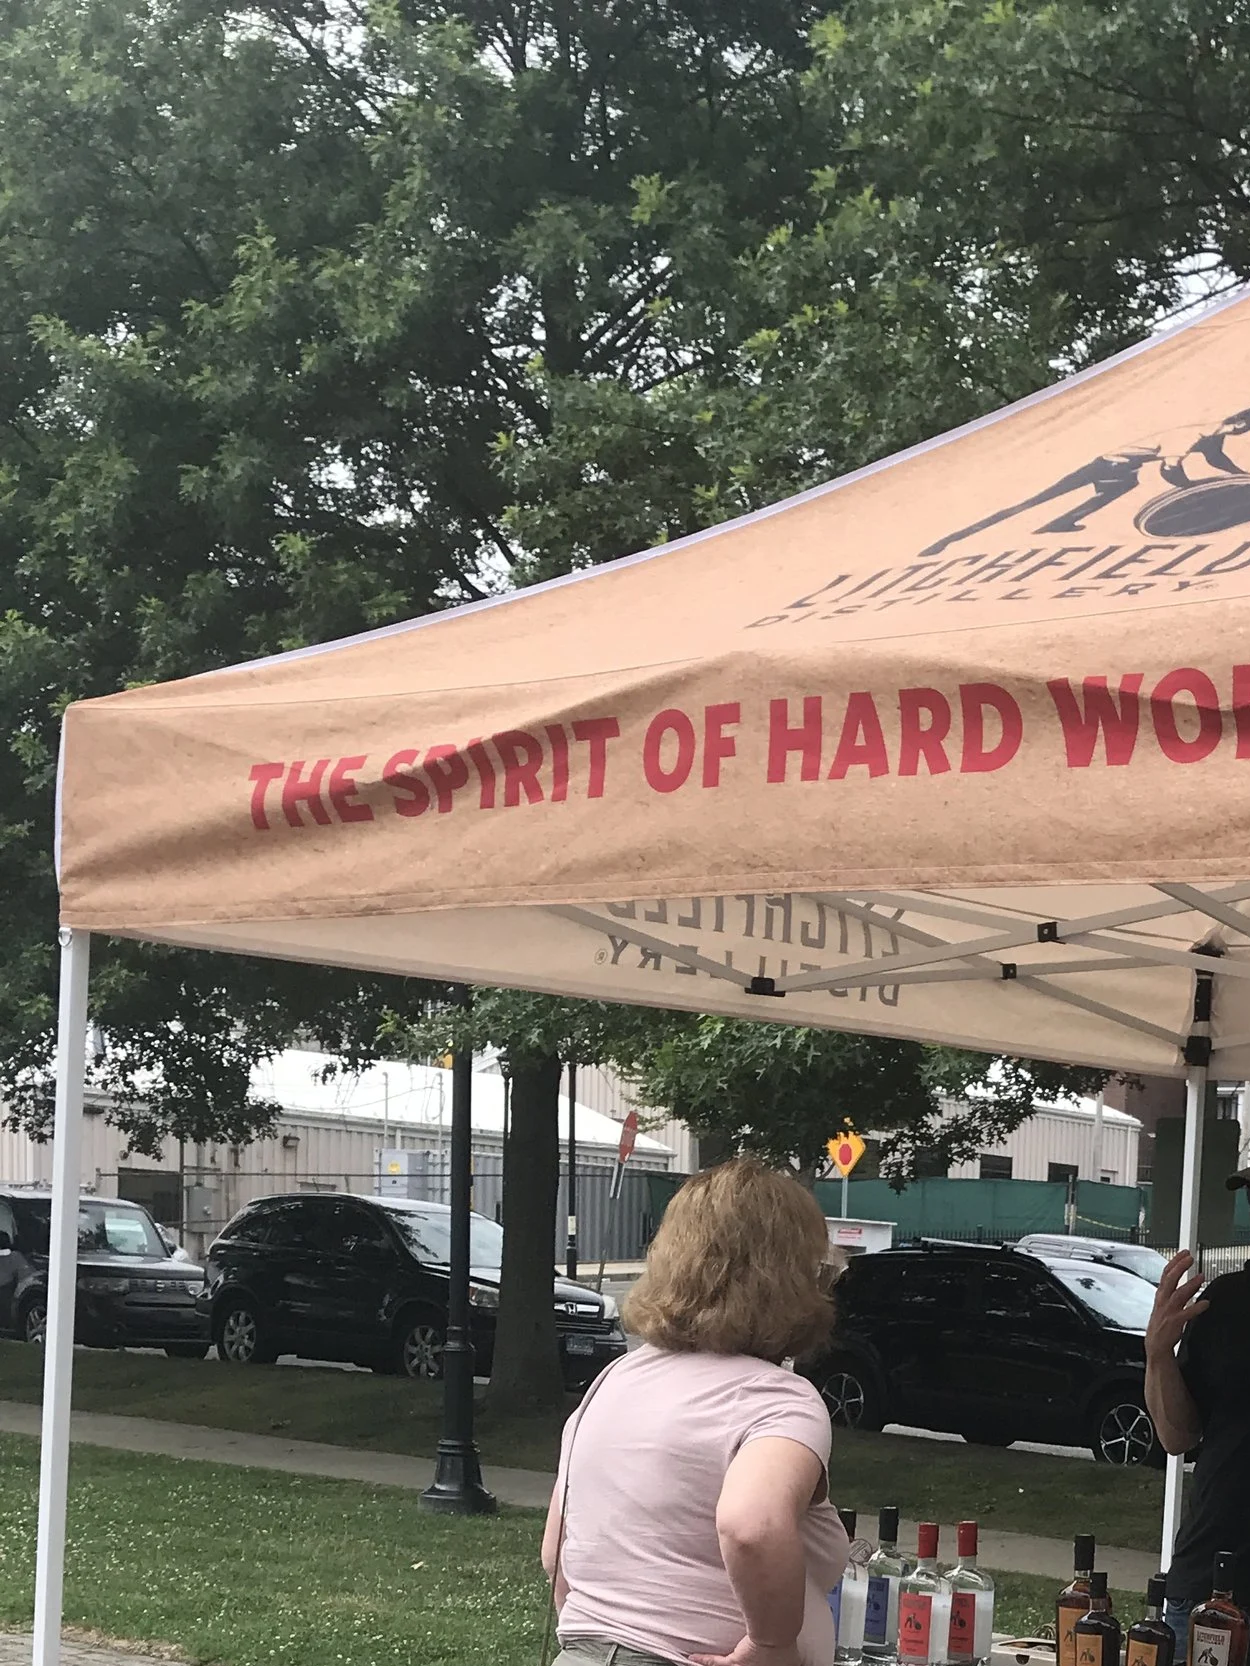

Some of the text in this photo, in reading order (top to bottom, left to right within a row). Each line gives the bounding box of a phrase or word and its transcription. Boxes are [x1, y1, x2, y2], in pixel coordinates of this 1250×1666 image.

[248, 755, 375, 830] THE
[382, 716, 621, 817] SPIRIT
[642, 701, 741, 793] OF
[766, 682, 1023, 783] HARD
